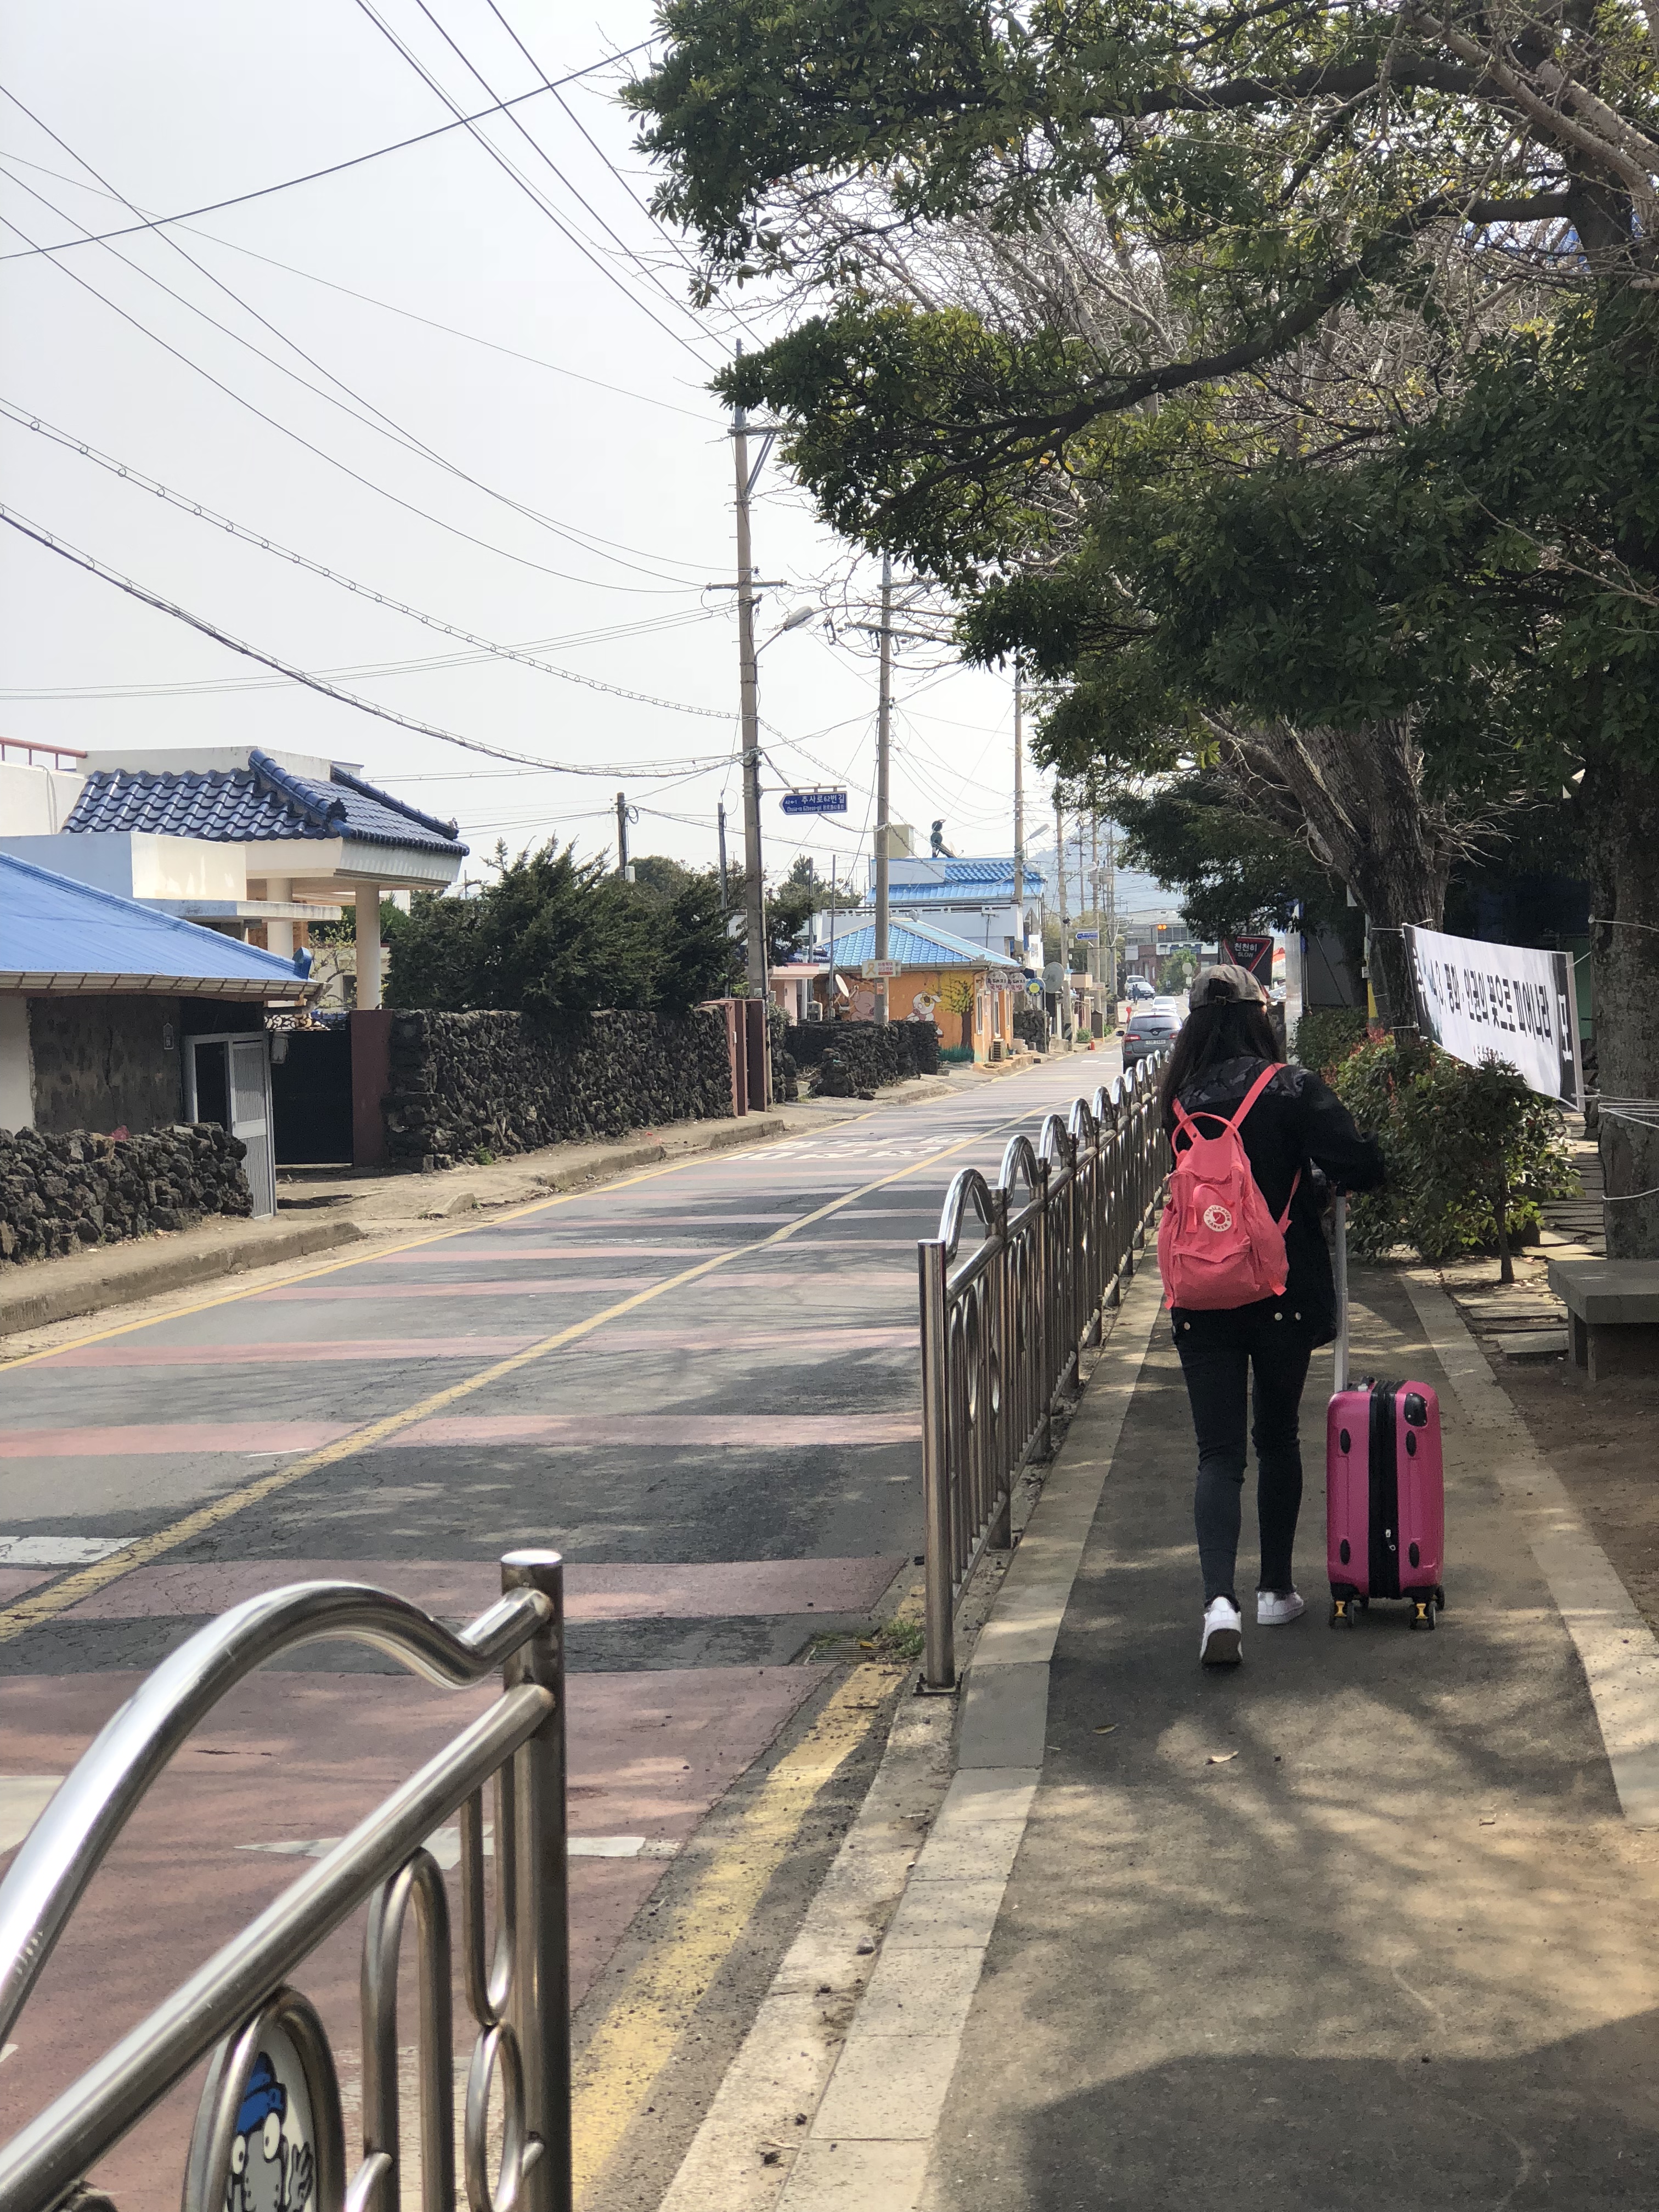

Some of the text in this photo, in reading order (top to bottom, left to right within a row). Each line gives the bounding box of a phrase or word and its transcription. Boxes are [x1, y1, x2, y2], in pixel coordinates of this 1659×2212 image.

[802, 794, 845, 804] 추사로62번길
[1234, 943, 1257, 952] 천천히
[1486, 974, 1516, 1032] 꽃으로
[1512, 980, 1553, 1046] 피어나라
